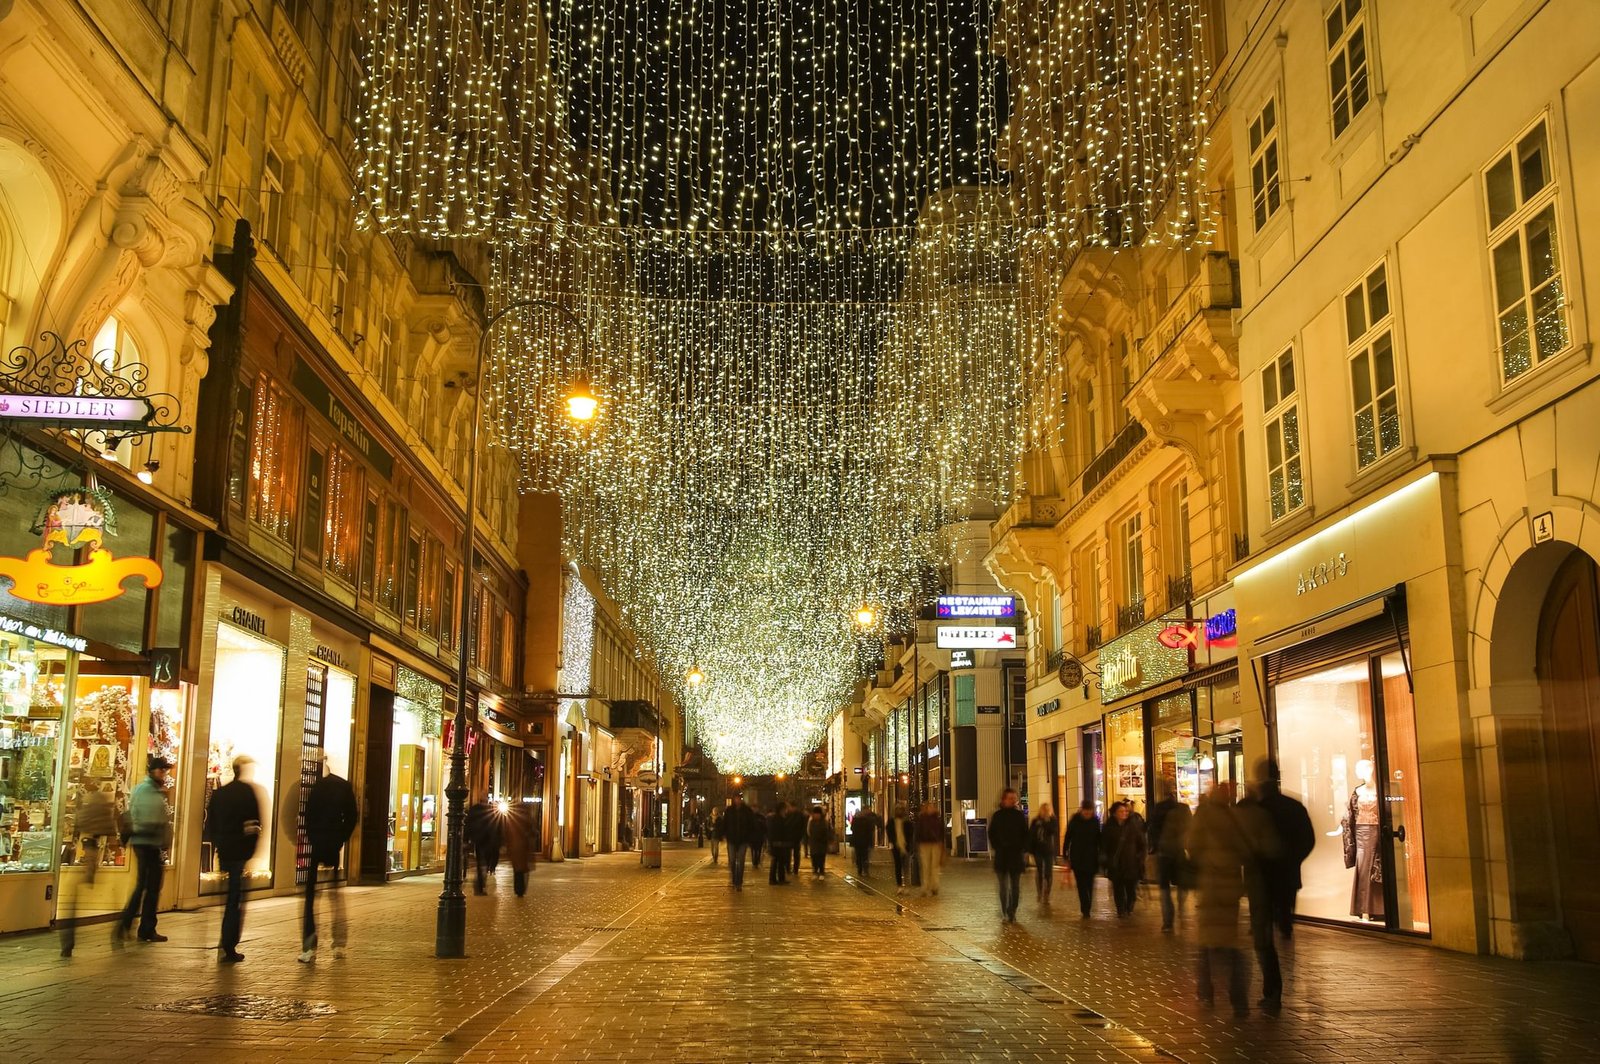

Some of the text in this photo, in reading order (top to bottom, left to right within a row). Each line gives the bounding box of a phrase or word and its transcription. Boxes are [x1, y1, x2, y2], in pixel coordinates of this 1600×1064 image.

[20, 399, 116, 417] SIEDLER
[1539, 518, 1548, 534] 4
[1296, 552, 1350, 597] AKRIS
[939, 596, 1013, 606] RESTAURANT
[232, 606, 268, 636] CHANEL
